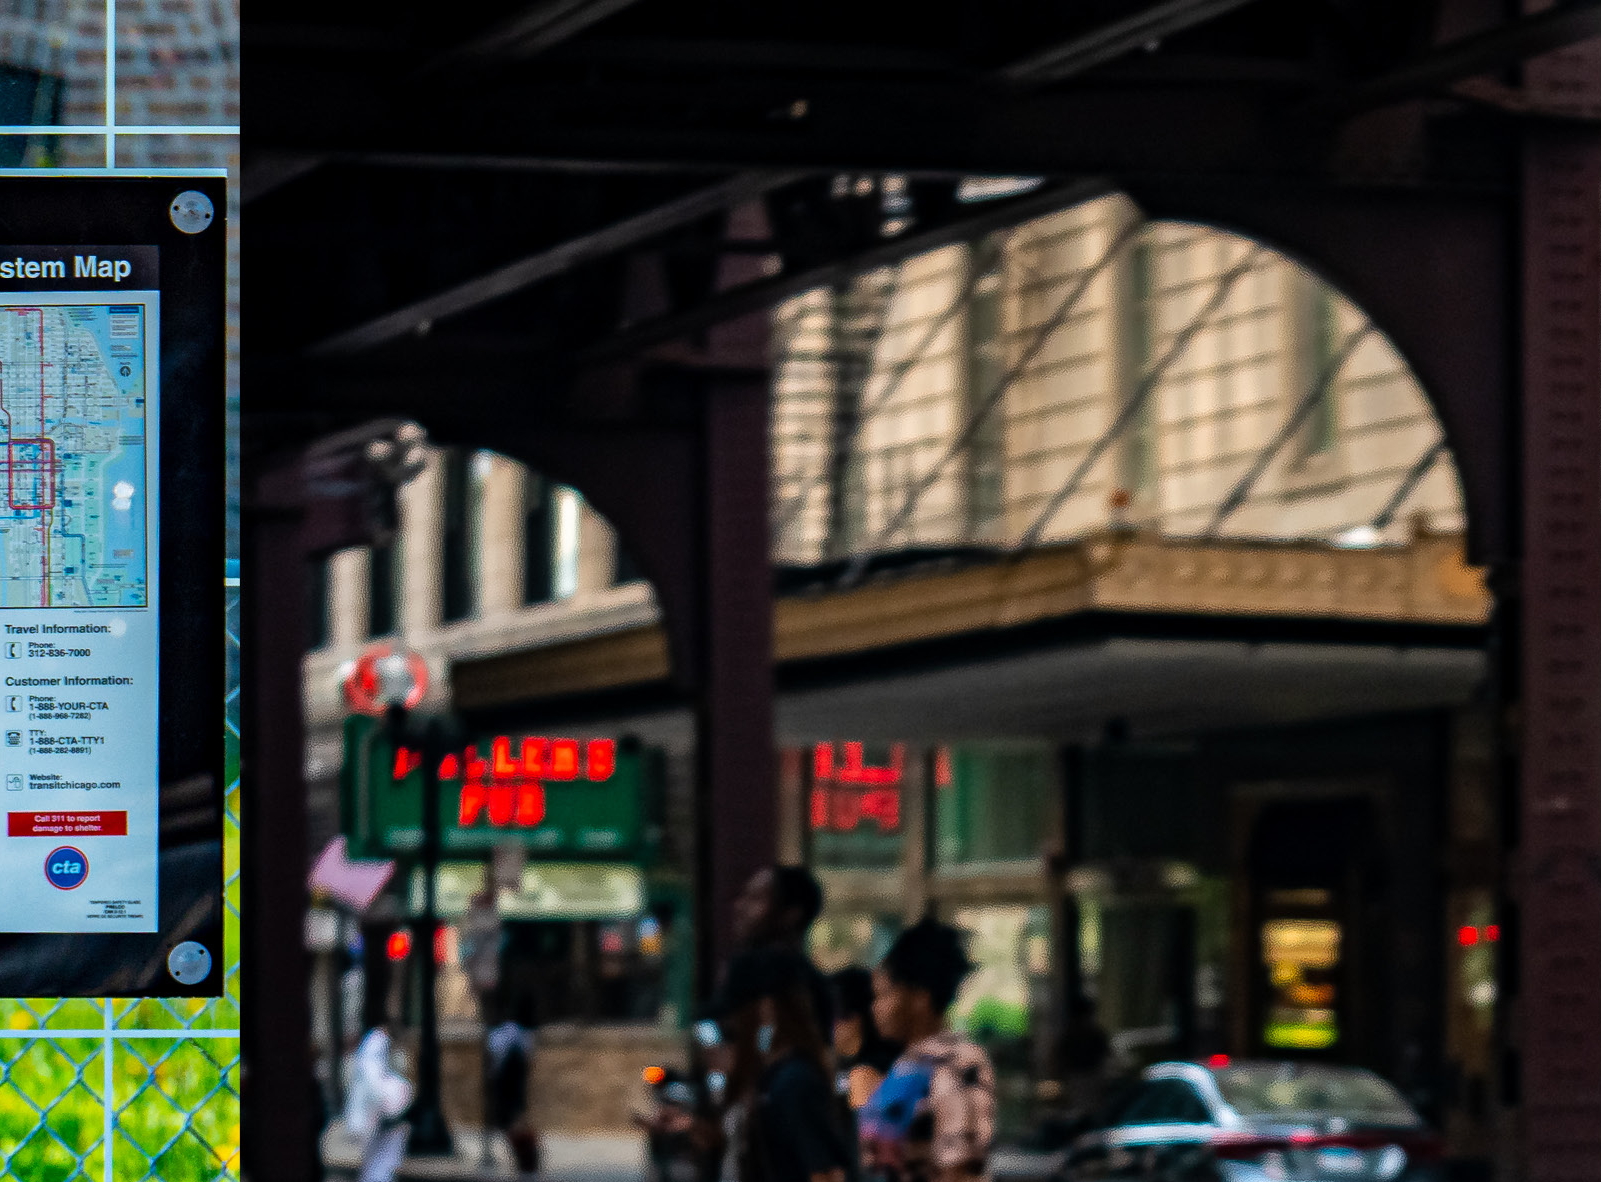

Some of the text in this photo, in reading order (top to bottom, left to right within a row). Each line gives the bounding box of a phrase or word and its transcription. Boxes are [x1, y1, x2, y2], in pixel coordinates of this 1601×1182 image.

[73, 255, 132, 283] Map
[5, 624, 112, 634] Travel Information:
[5, 675, 134, 687] Customer Information:
[29, 702, 109, 711] 1-888-YOUR-CTA
[29, 736, 105, 745] 1-888-CTA-TTY1
[29, 781, 121, 791] transitchicago.com
[77, 815, 101, 823] report
[32, 825, 64, 833] damage
[64, 824, 73, 832] to
[51, 860, 82, 875] cta
